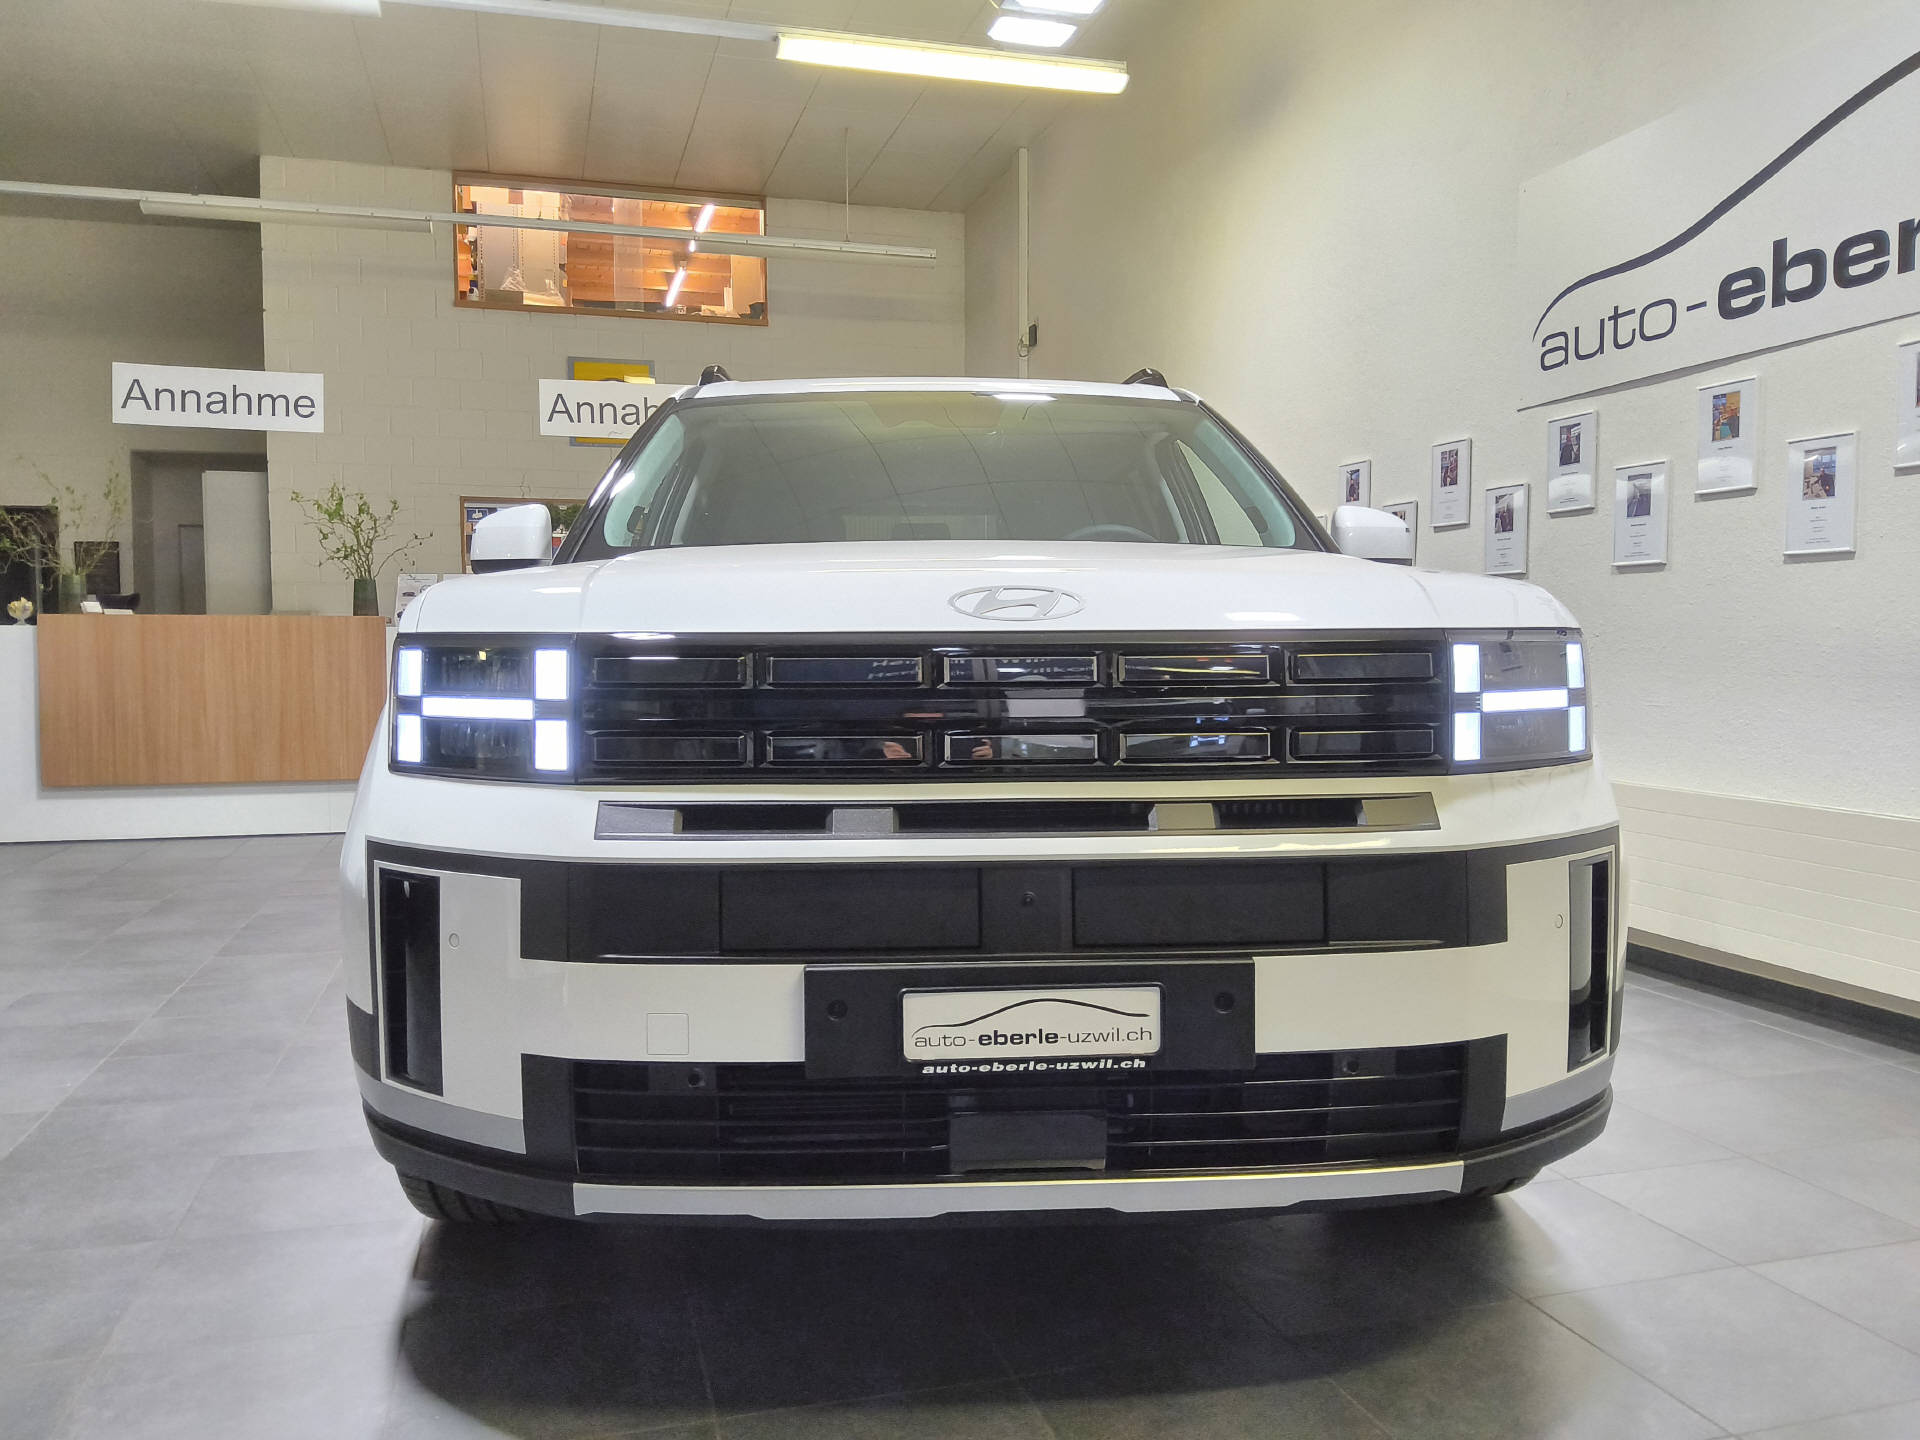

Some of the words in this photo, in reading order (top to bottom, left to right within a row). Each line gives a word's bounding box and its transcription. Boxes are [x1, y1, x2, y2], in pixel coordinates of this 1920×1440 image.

[120, 379, 316, 418] Annahme
[914, 1028, 1153, 1048] auto-eberle-uzwil.ch
[922, 1058, 1146, 1074] auto-eberle-uzwil.ch
